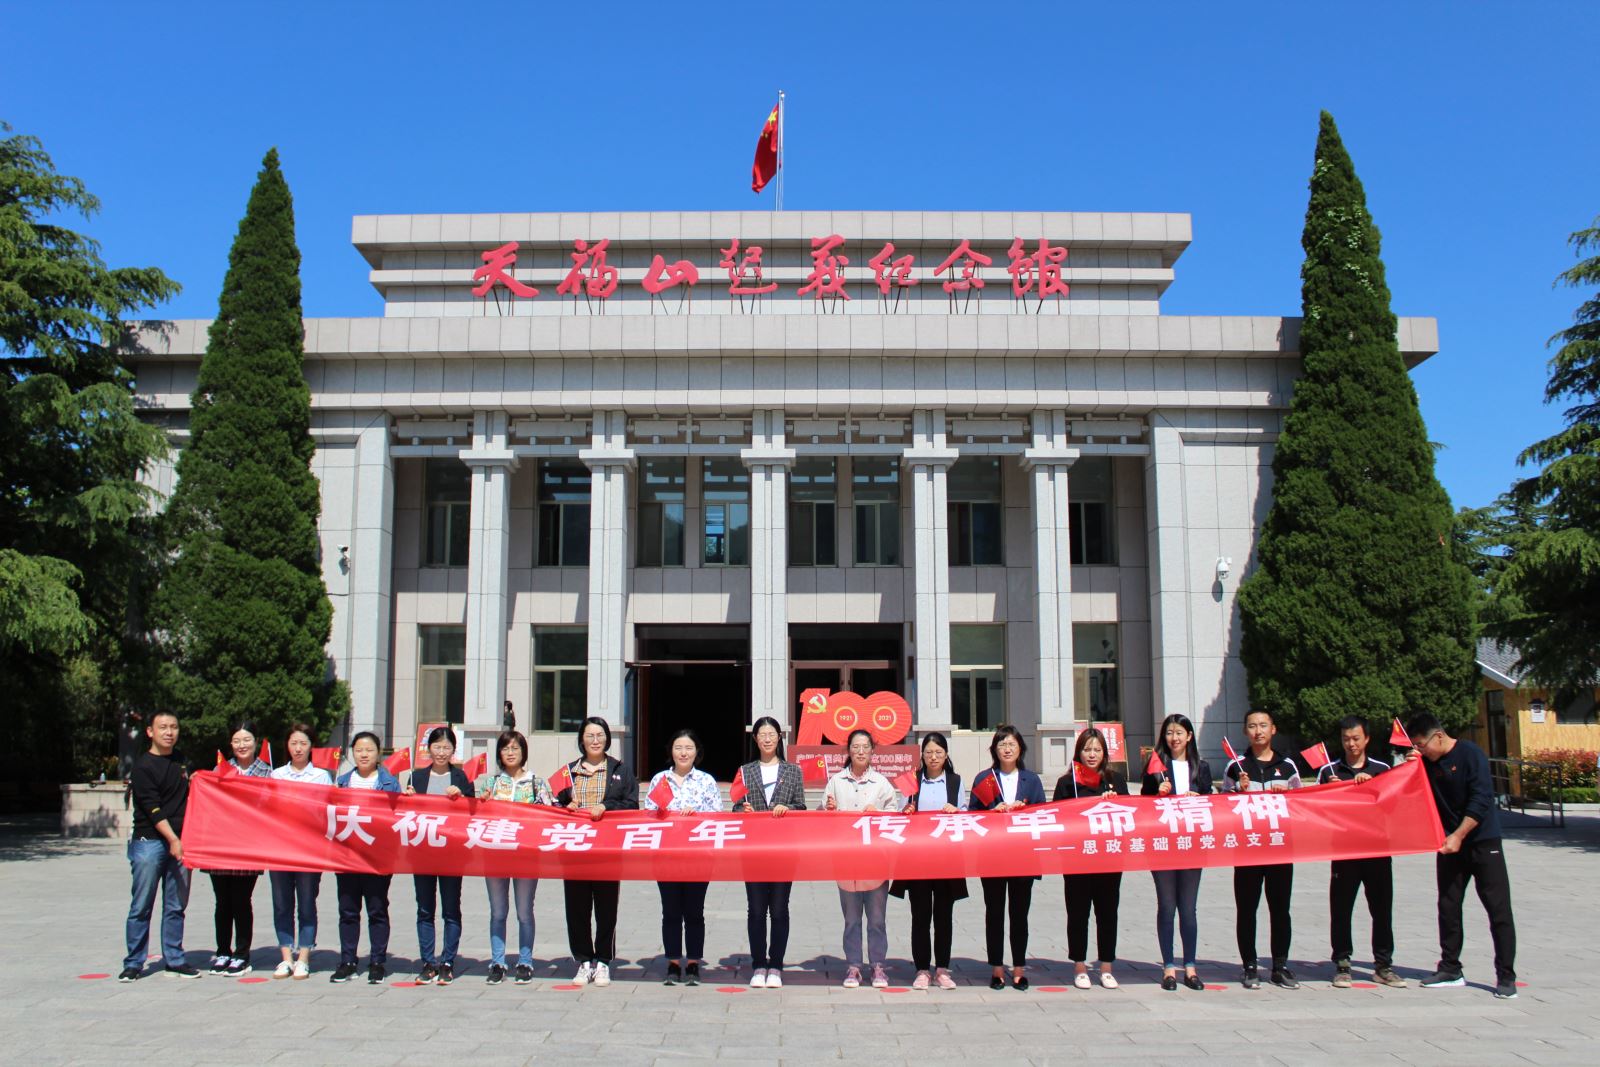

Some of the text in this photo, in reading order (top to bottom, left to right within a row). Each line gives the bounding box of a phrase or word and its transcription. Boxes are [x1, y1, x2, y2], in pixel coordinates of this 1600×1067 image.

[852, 794, 1290, 846] 传承革命精神
